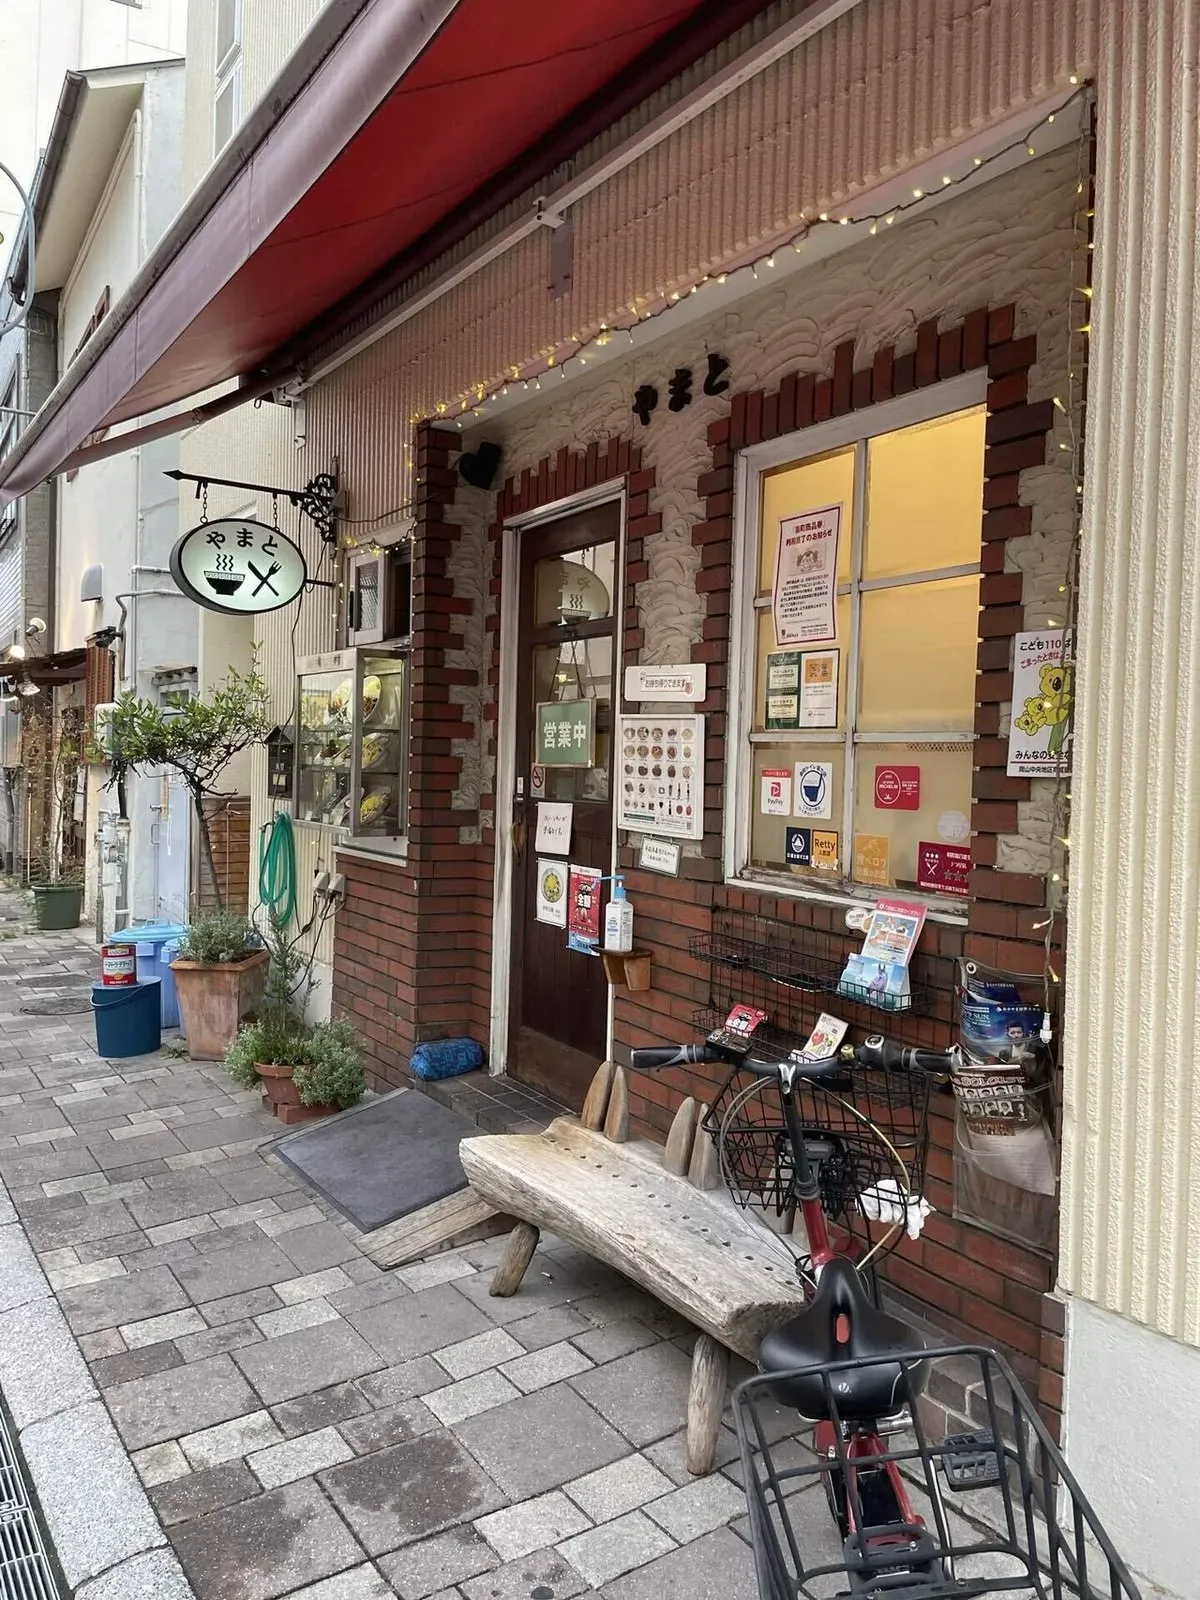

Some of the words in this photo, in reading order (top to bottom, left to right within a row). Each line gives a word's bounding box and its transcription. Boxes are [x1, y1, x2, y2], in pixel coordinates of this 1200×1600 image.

[632, 353, 730, 426] やまと
[206, 528, 278, 557] やまと
[543, 720, 586, 749] 営業中
[768, 798, 783, 806] PayPay
[815, 839, 835, 850] Retty
